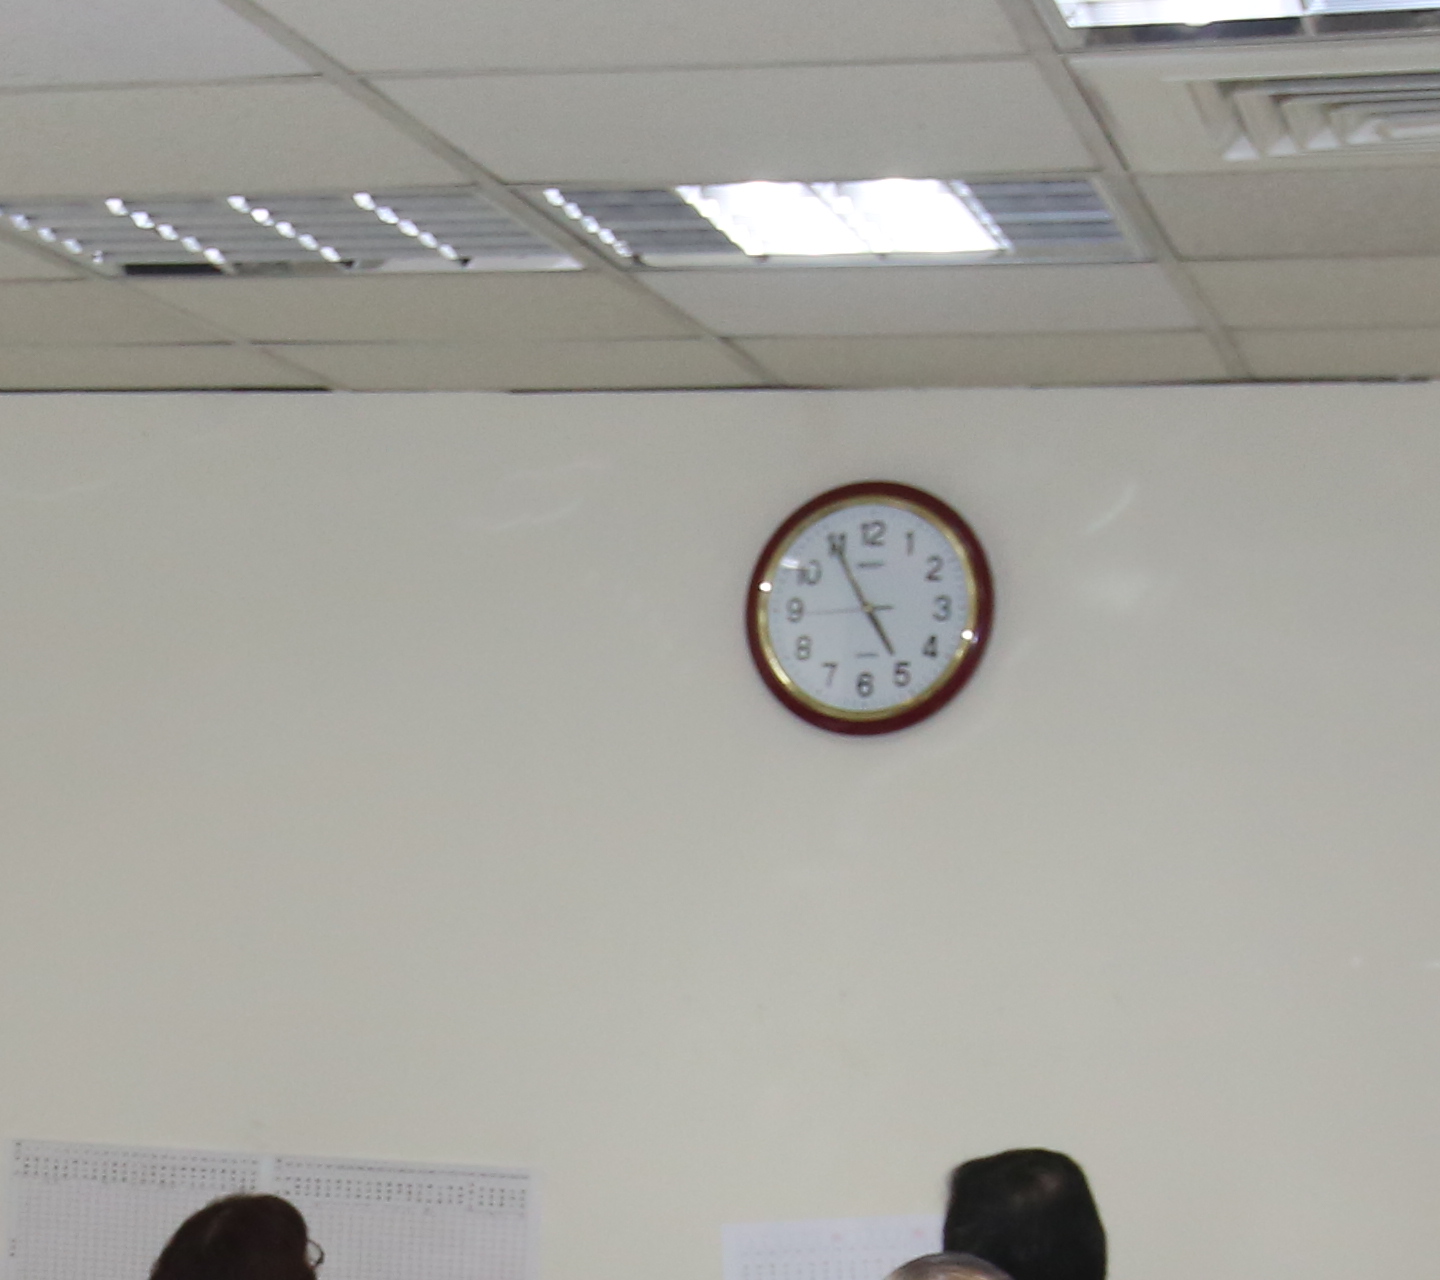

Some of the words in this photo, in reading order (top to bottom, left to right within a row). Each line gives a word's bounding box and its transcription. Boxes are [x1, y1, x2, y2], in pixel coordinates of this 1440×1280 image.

[827, 532, 847, 556] 11
[860, 520, 887, 547] 12
[906, 531, 915, 555] 1
[797, 560, 822, 585] 10
[925, 555, 943, 581] 2
[787, 598, 804, 623] 9
[932, 595, 952, 621] 3
[796, 635, 812, 660] 8
[922, 635, 938, 658] 4
[822, 662, 838, 687] 7
[856, 671, 874, 697] 6
[893, 661, 911, 687] 5
